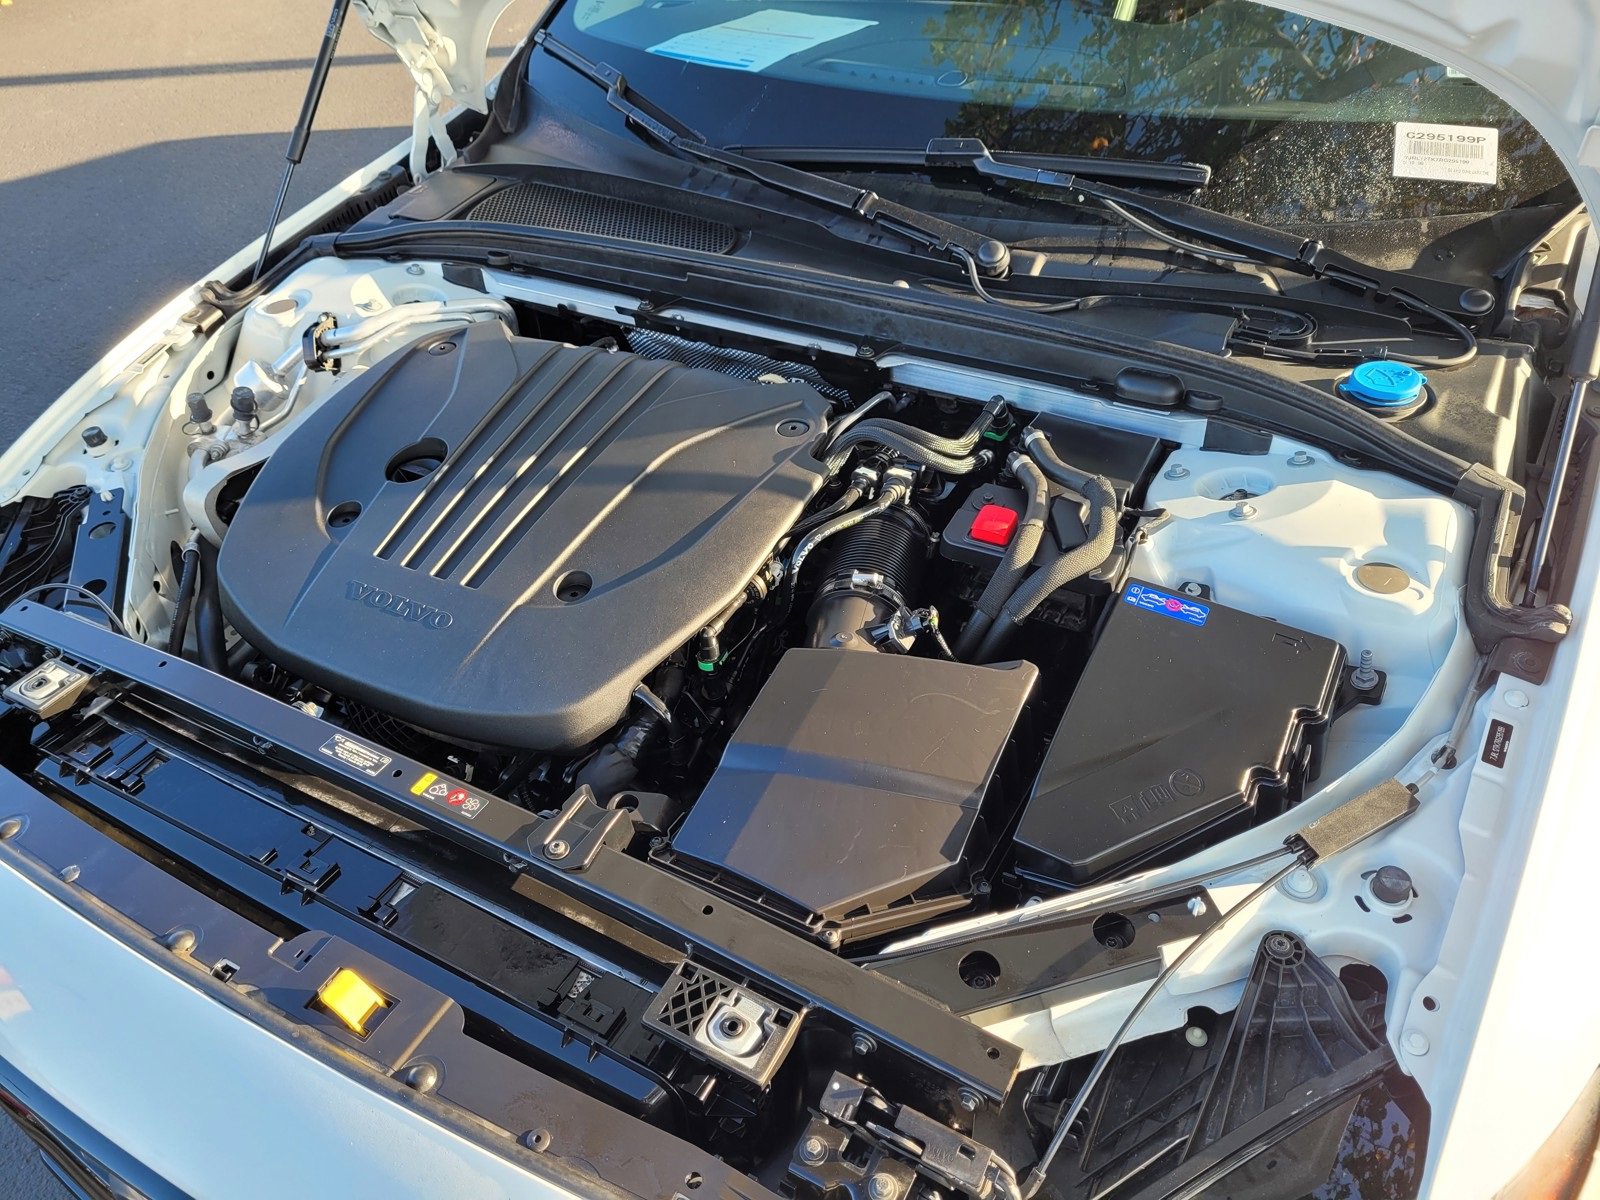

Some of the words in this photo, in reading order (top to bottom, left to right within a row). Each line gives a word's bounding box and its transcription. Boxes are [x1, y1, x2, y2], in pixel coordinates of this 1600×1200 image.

[1406, 132, 1487, 143] G295199P
[792, 542, 814, 574] VOLVO
[346, 580, 453, 630] VOLVO
